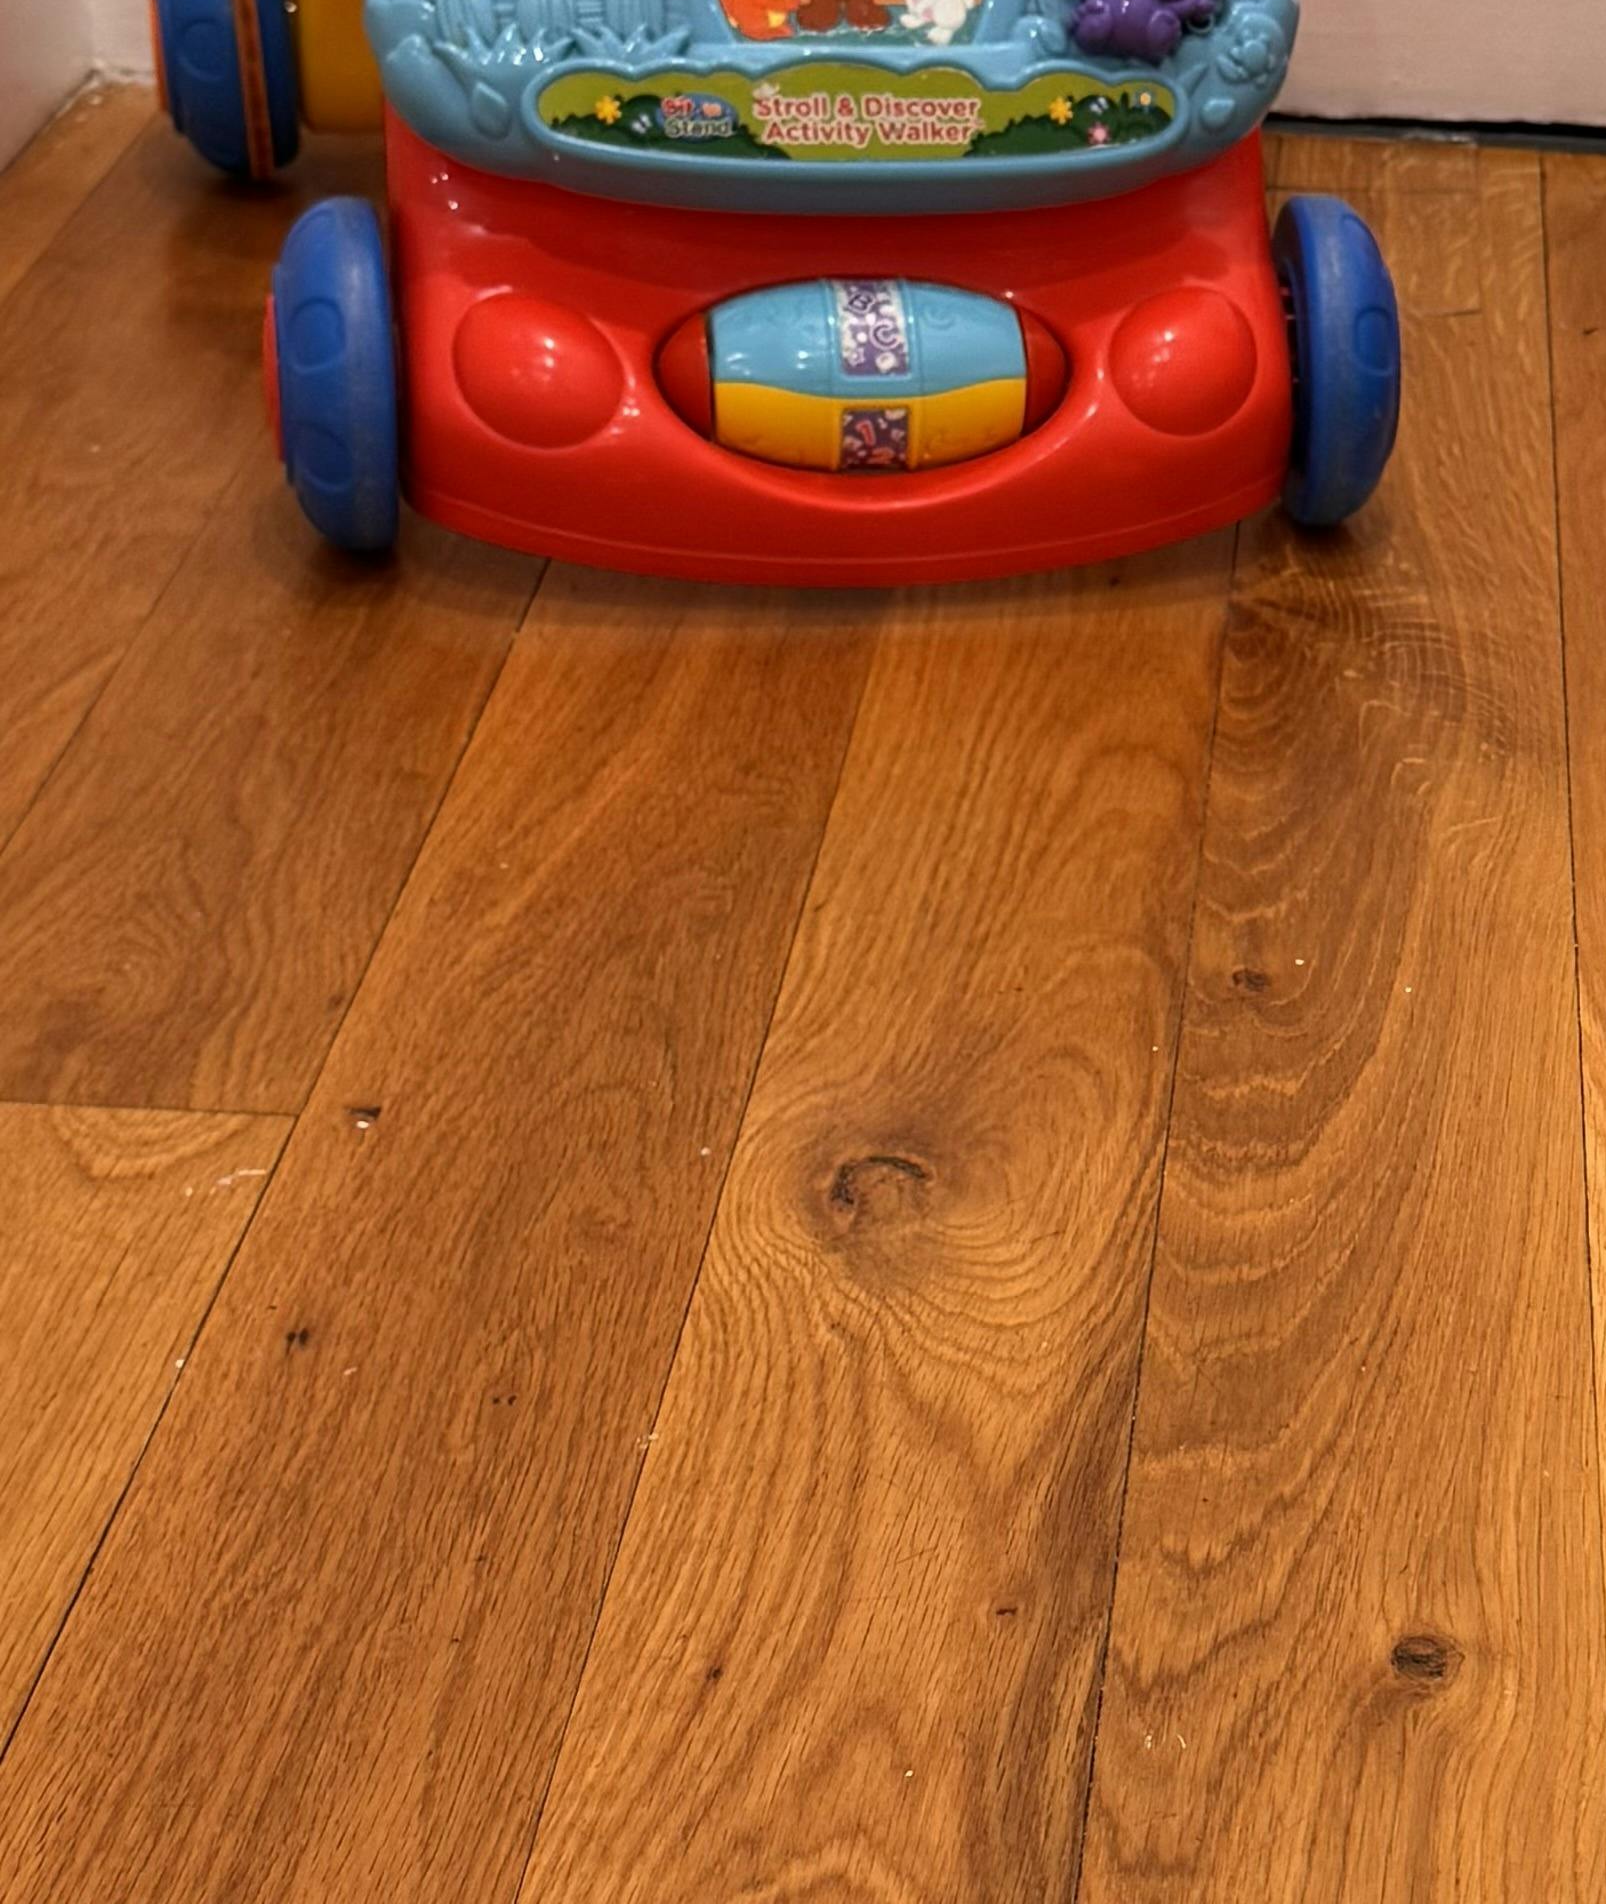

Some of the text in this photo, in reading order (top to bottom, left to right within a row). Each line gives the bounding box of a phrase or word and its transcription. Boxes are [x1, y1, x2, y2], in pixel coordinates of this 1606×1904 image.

[755, 96, 979, 117] Stroll & Discover
[766, 121, 869, 145] Activity
